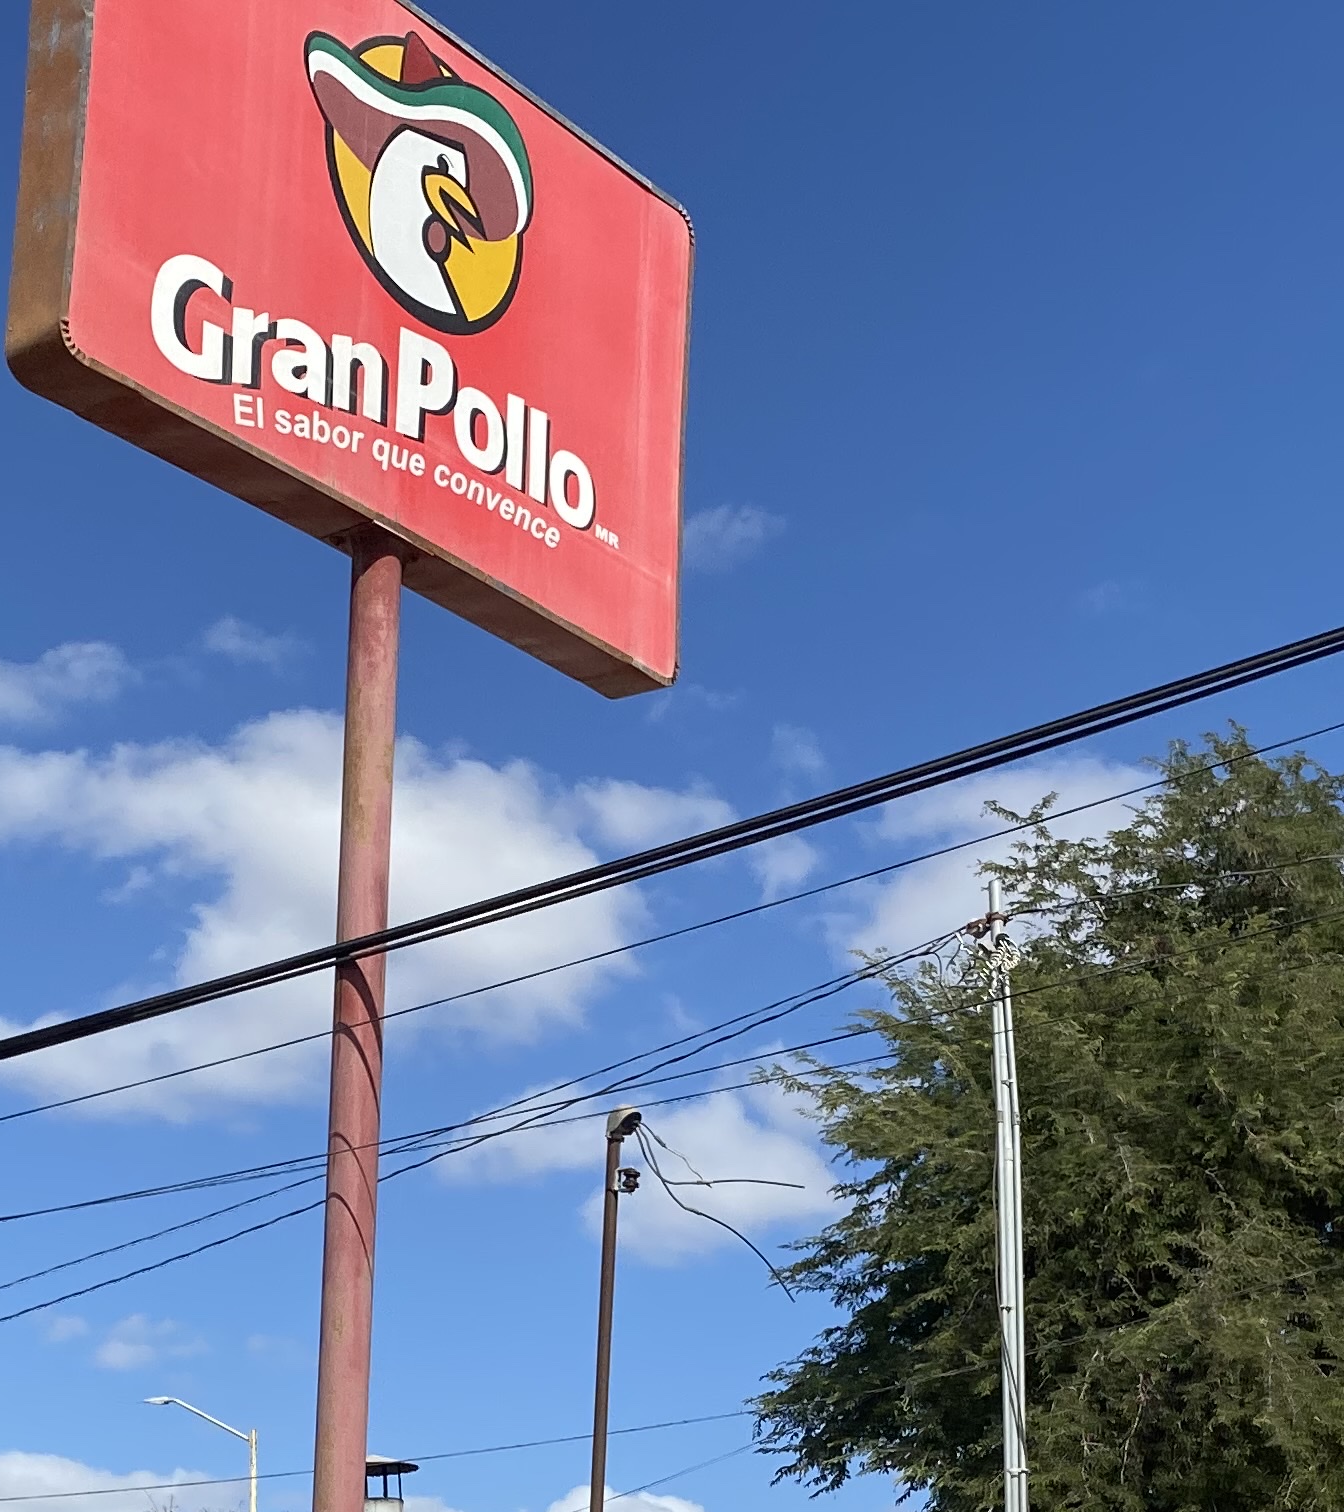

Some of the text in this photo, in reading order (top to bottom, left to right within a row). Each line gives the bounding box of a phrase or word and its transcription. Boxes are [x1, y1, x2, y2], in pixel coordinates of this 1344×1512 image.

[150, 253, 597, 532] Gran Pollo
[232, 393, 561, 549] El sabor que convence
[594, 523, 620, 549] MR
